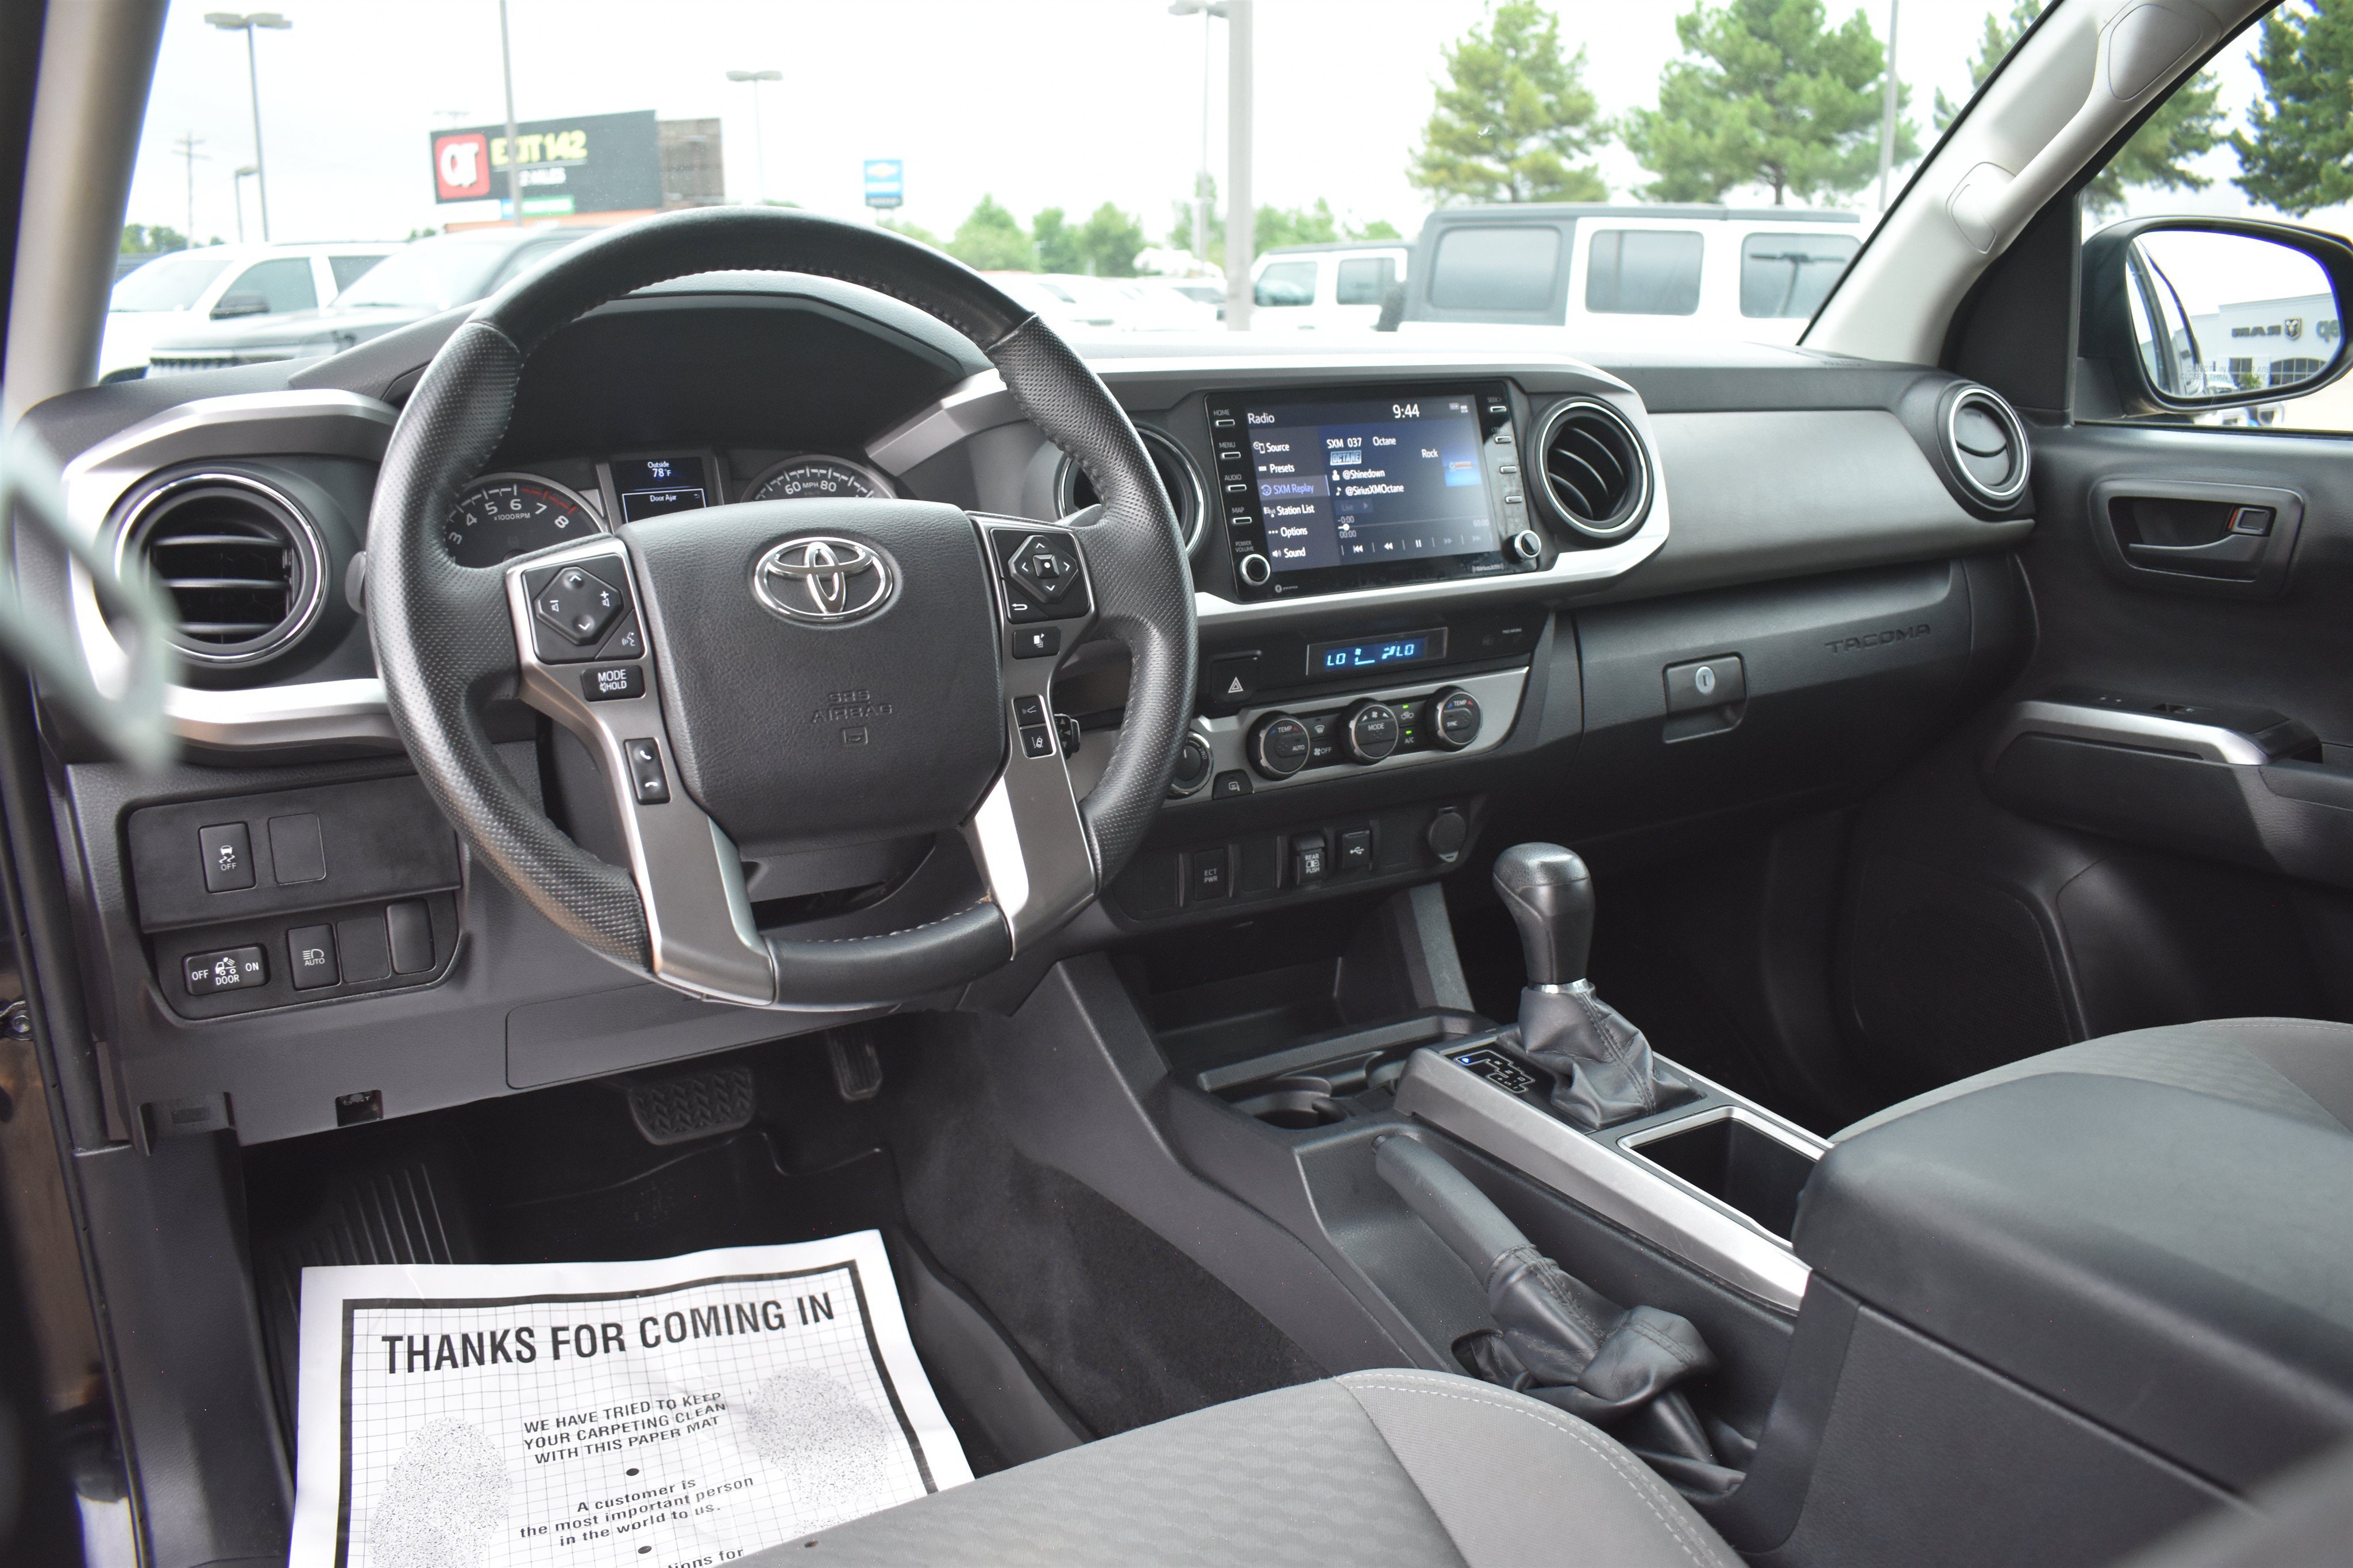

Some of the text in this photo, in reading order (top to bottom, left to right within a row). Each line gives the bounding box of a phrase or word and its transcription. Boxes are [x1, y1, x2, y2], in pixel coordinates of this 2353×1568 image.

[491, 129, 588, 166] EIT 142
[440, 143, 479, 187] QT
[1392, 404, 1419, 419] 9:44
[1247, 412, 1275, 424] Radio
[1267, 442, 1290, 452] Source
[1326, 437, 1362, 449] SXM 037
[1372, 436, 1397, 446] Octane
[1332, 451, 1360, 464] OCTANE
[1421, 449, 1438, 458] Rock
[652, 468, 672, 477] 78°F
[1270, 464, 1295, 473] Presets
[1343, 469, 1386, 480] @Shinedown
[785, 481, 801, 495] 60
[820, 480, 837, 492] 80
[1274, 484, 1314, 495] SXM Replay
[1345, 484, 1405, 497] @SiriusXMOctane
[665, 494, 677, 502] Ajar
[484, 501, 498, 515] 5
[510, 499, 522, 510] 6
[535, 502, 547, 515] 7
[1277, 504, 1315, 516] Station List
[466, 513, 477, 526] 4
[554, 515, 569, 528] 8
[448, 531, 462, 544] 3
[1280, 526, 1308, 539] Options
[1339, 530, 1356, 539] 00:00
[1284, 547, 1306, 558] Sound
[1824, 623, 1932, 655] TACOMA
[597, 670, 627, 683] MODE
[607, 680, 627, 691] HOLD
[811, 704, 893, 724] AIRBAG
[1278, 725, 1293, 733] TEMP
[1368, 723, 1384, 731] MODE
[1321, 747, 1333, 755] OFF
[221, 862, 237, 871] OFF
[1204, 875, 1218, 883] PWR
[245, 962, 259, 972] ON
[304, 957, 325, 966] AUTO
[191, 970, 209, 981] OFF
[215, 974, 240, 986] DOOR
[381, 1292, 834, 1374] THANKS FOR COMING IN
[524, 1392, 722, 1434] WE HAVE TRIED TO KEEP
[524, 1403, 726, 1450] YOUR CARPETING CLEAN
[535, 1416, 720, 1464] WITH THIS PAPER MAT
[576, 1478, 696, 1512] A customer is
[520, 1477, 754, 1538] the most important person
[560, 1503, 721, 1546] in the world to us.
[719, 1548, 743, 1561] for
